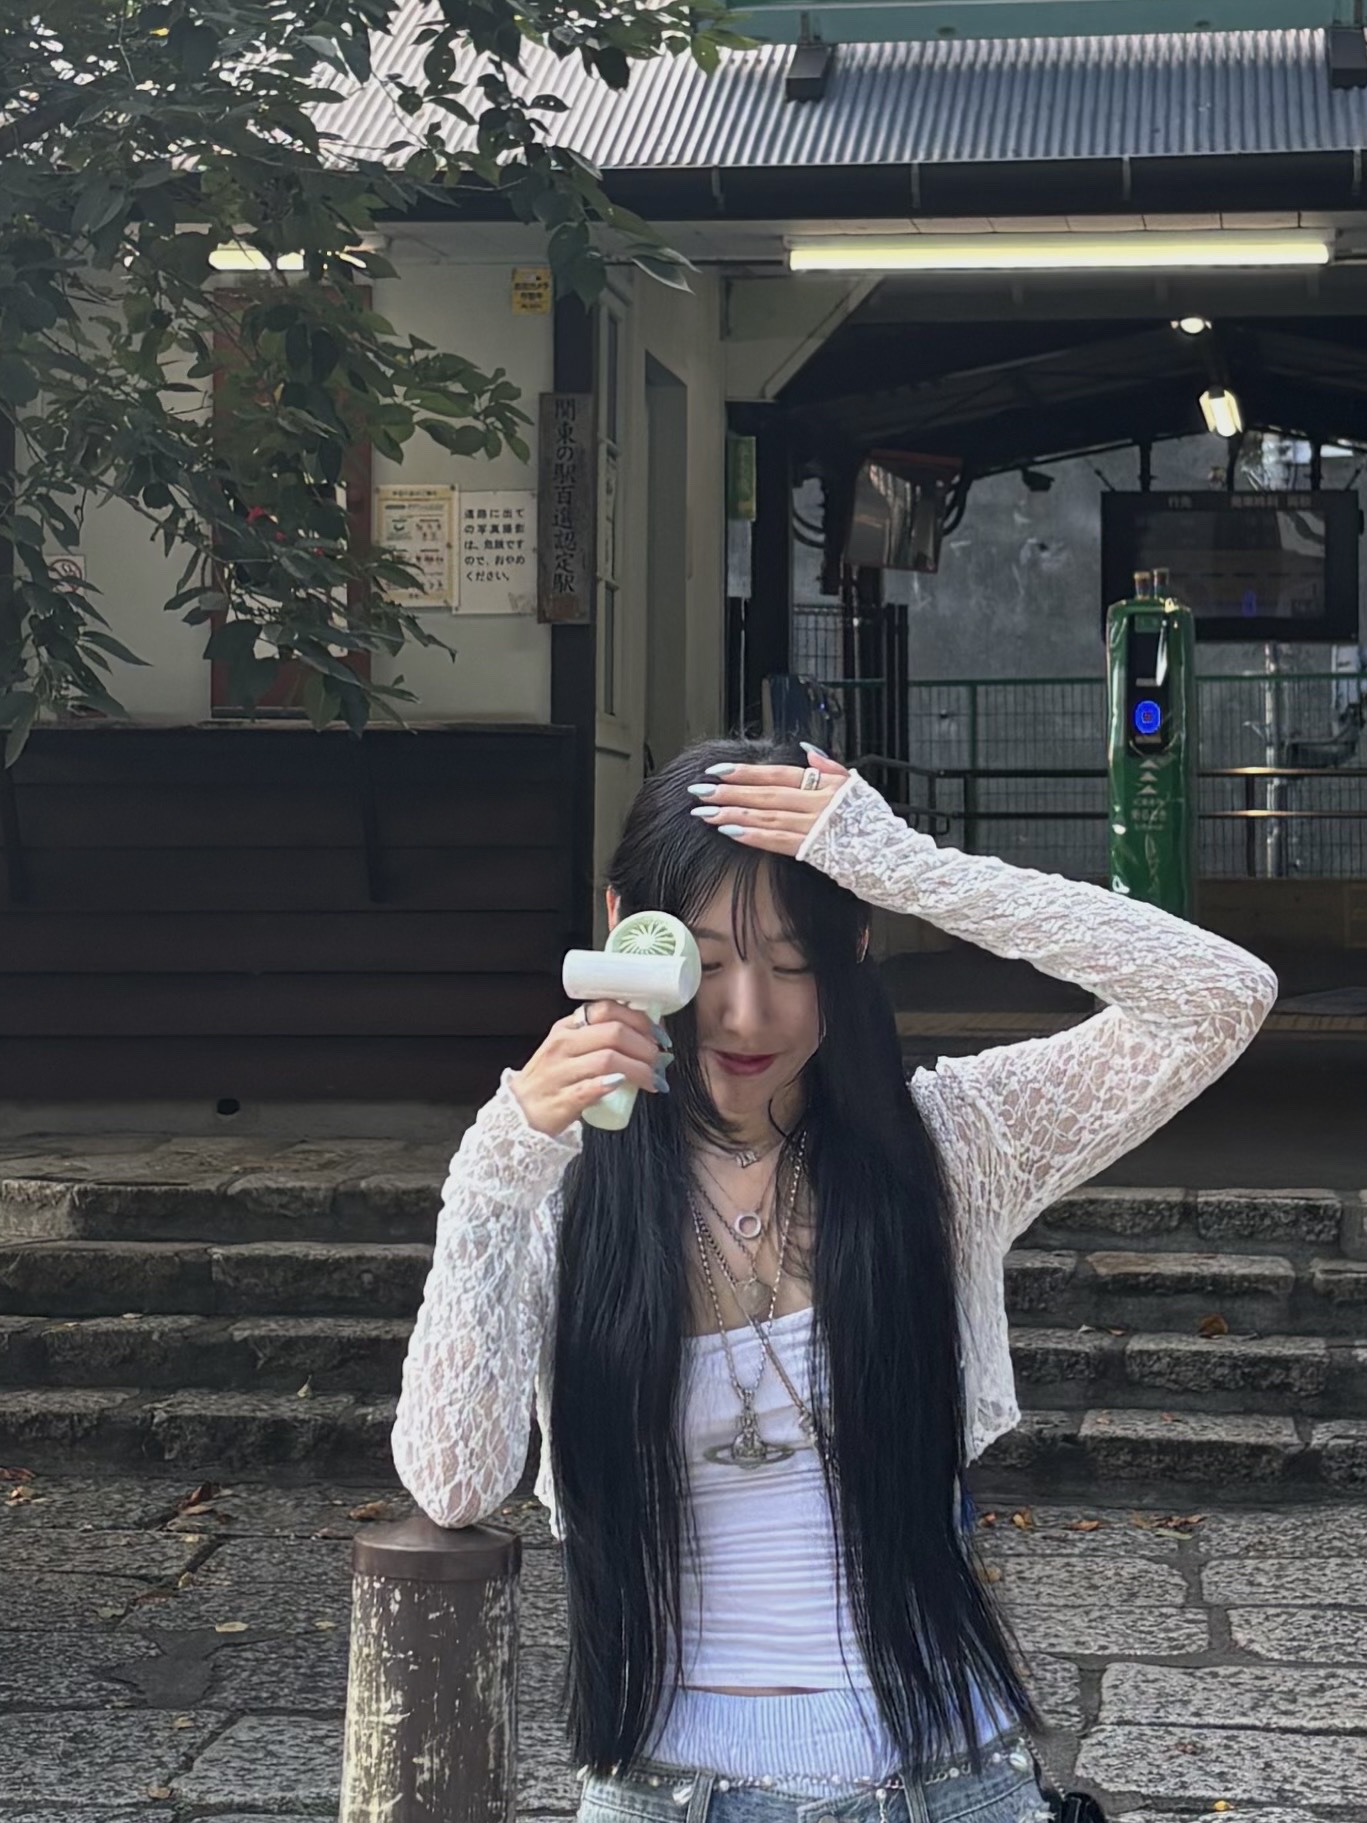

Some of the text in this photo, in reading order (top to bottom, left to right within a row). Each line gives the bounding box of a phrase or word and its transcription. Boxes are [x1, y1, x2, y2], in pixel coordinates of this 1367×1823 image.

[552, 397, 577, 594] 関東の駅百選認定駅
